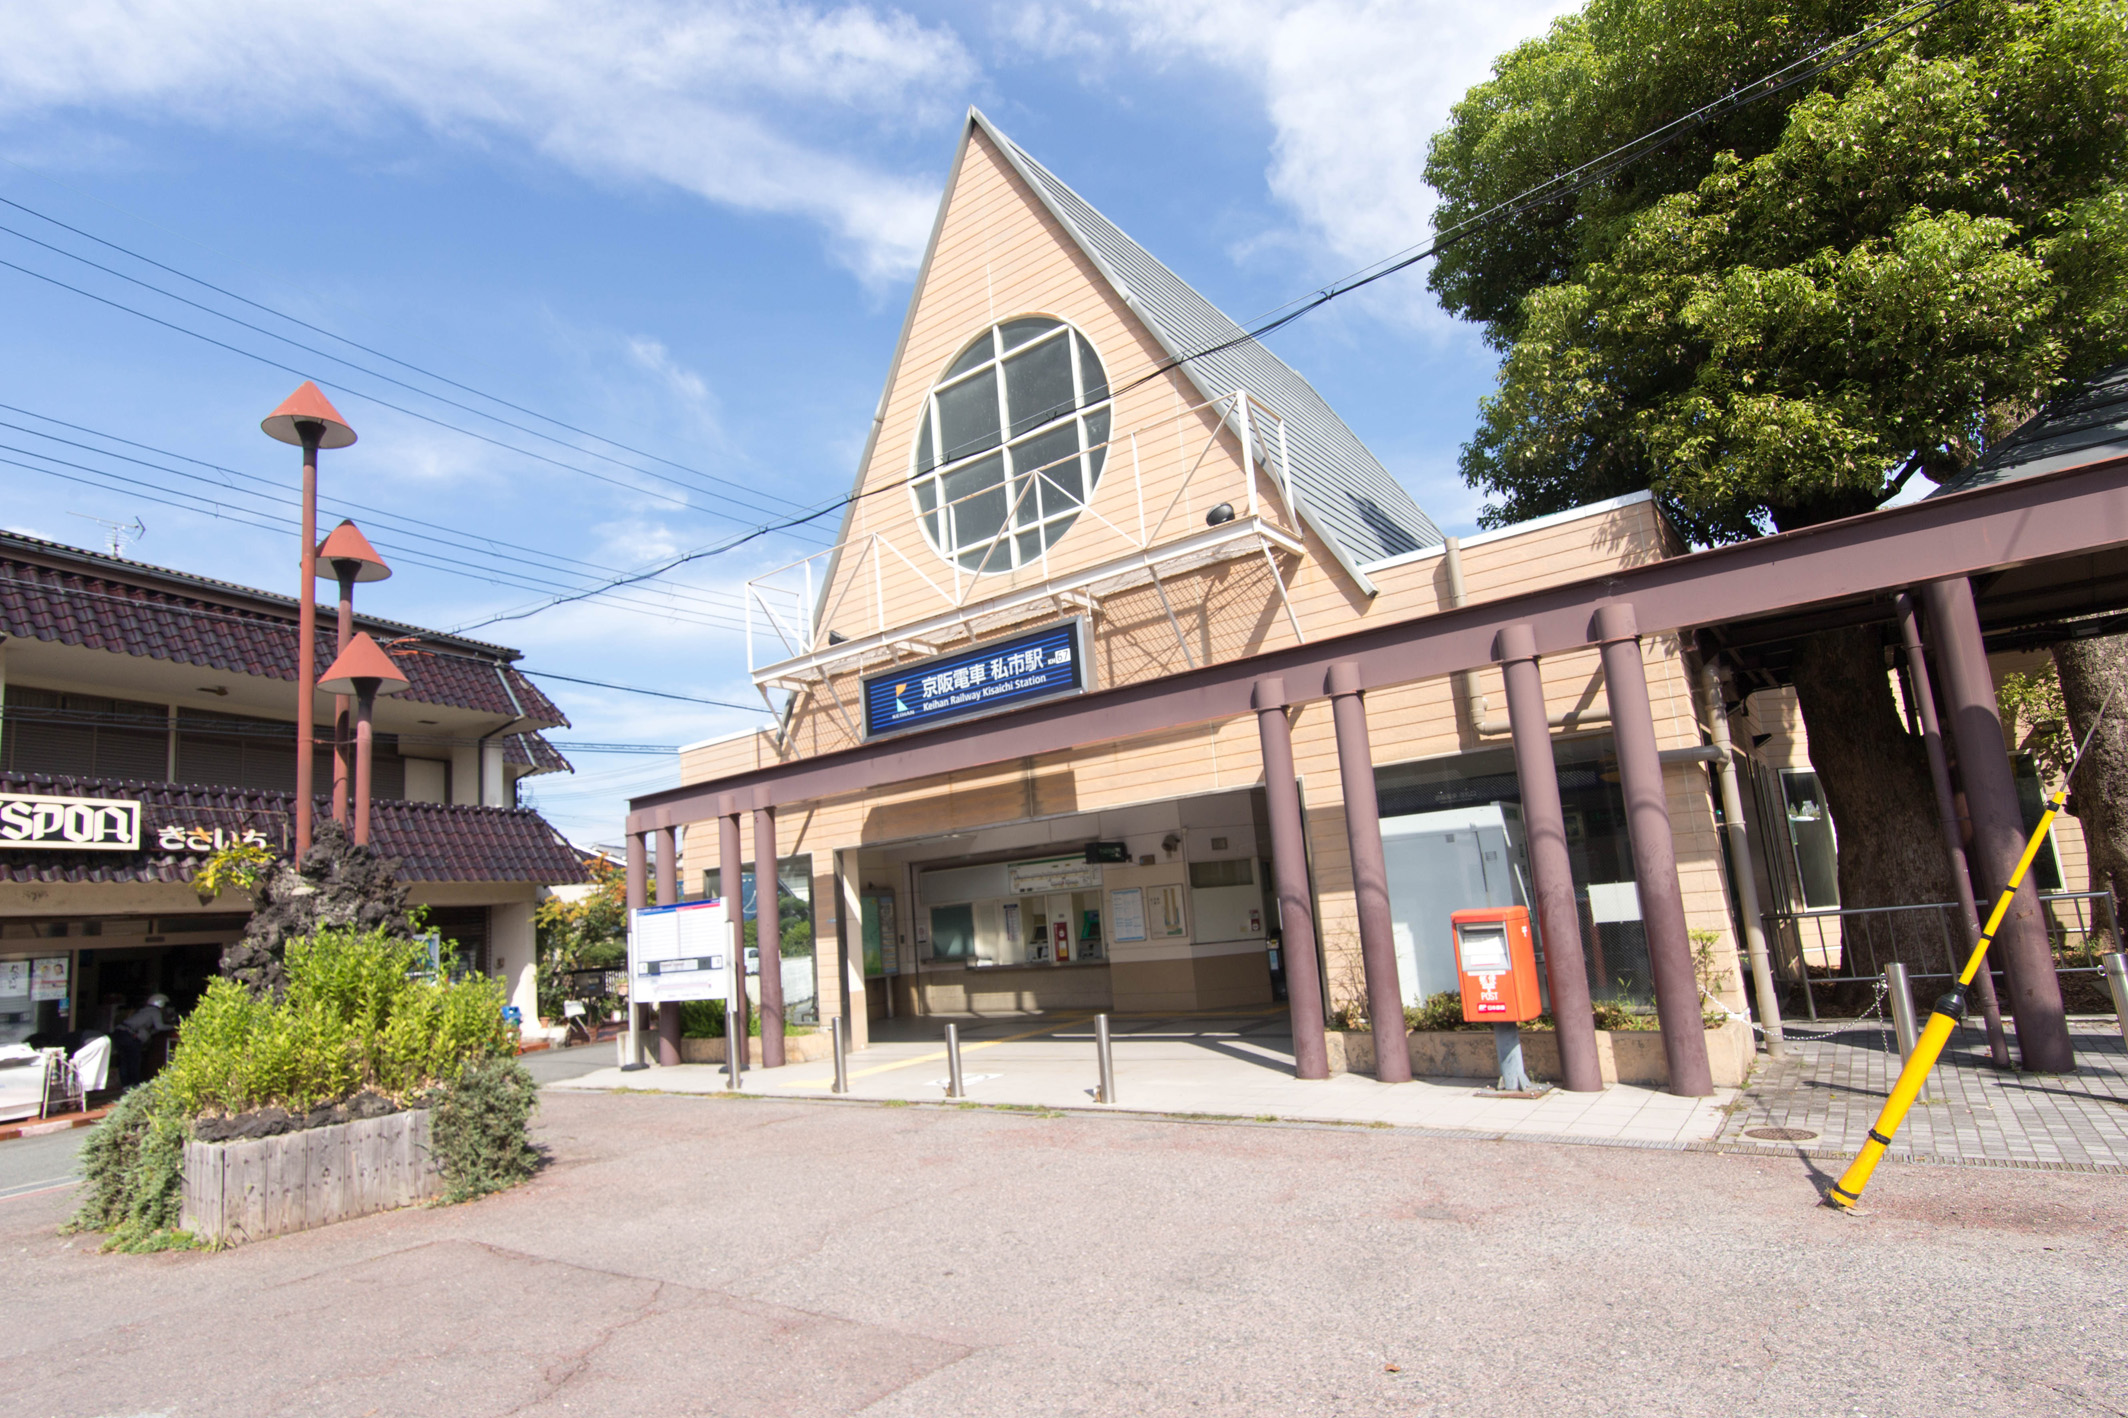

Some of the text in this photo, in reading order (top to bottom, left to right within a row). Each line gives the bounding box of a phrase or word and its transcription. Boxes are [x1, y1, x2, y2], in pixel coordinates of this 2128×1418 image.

[1057, 649, 1069, 662] 67
[921, 647, 1044, 698] 京阪電車 私市駅
[923, 674, 1047, 711] Keihan Railway Kisaichi Station
[892, 709, 915, 719] KEIHAN
[158, 825, 267, 851] きさいち
[1481, 992, 1498, 1001] POST
